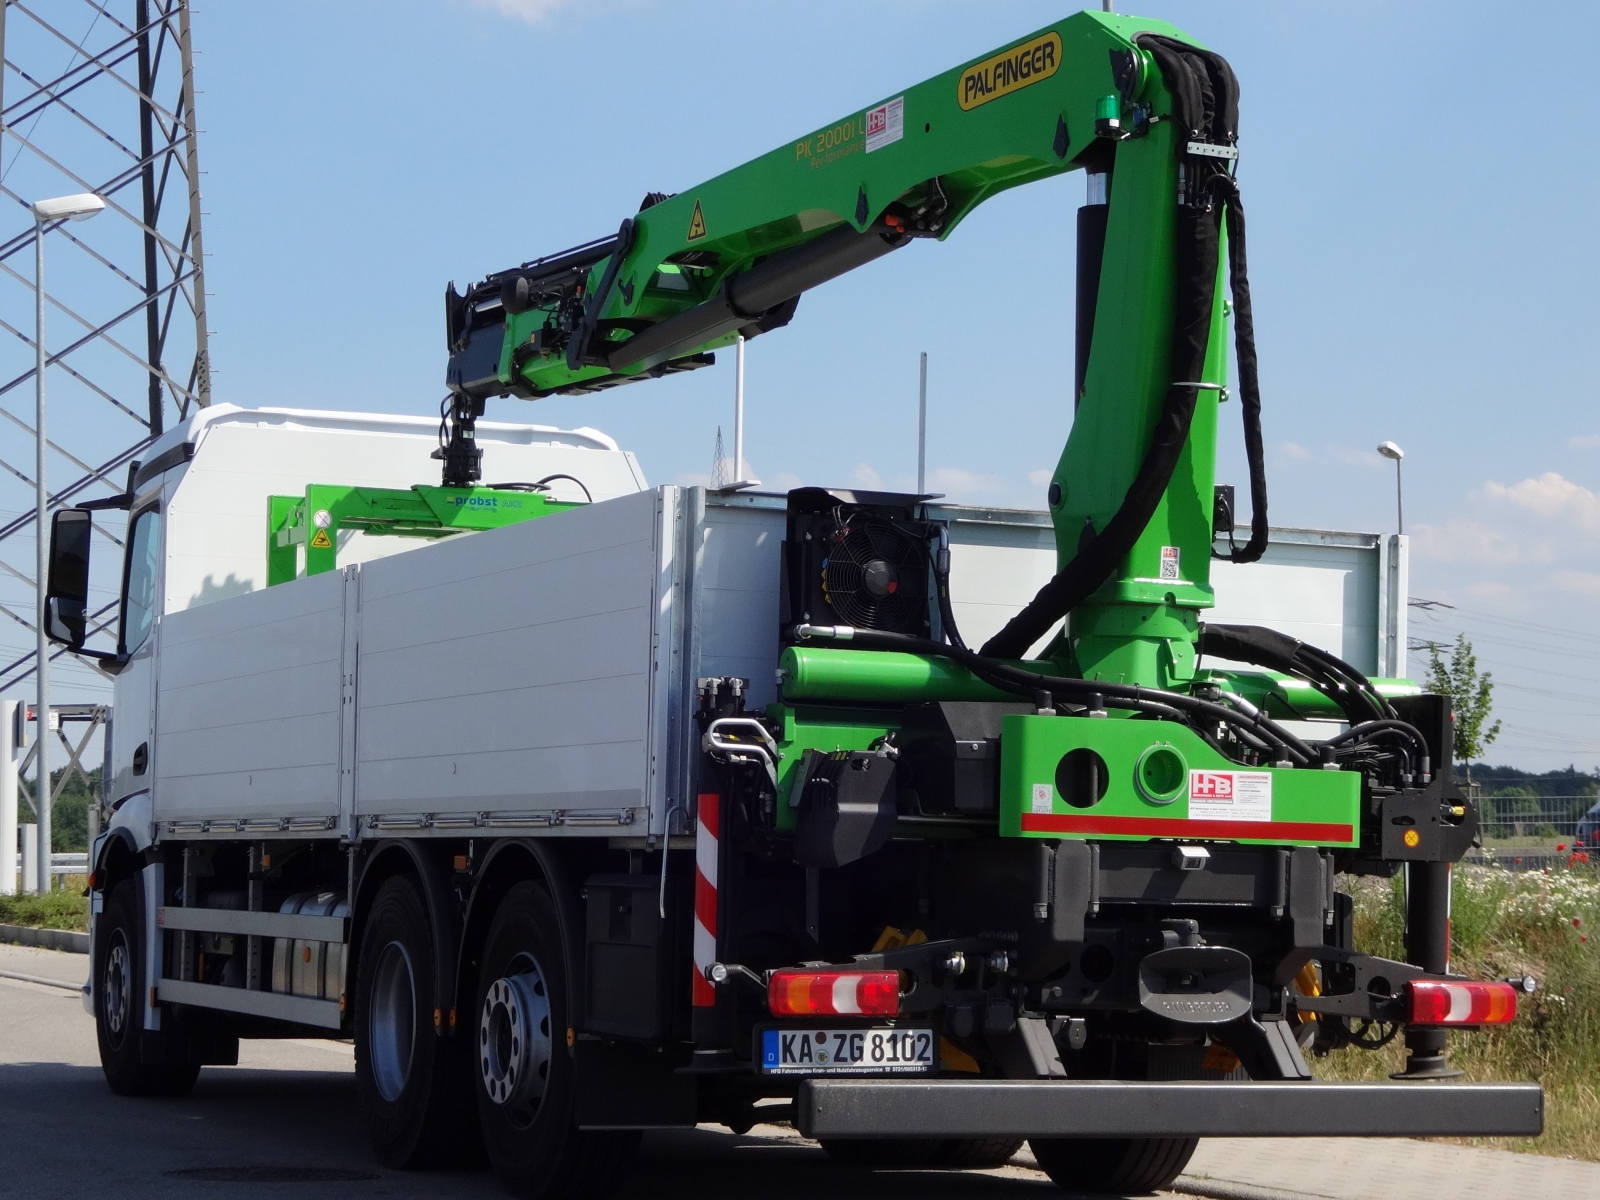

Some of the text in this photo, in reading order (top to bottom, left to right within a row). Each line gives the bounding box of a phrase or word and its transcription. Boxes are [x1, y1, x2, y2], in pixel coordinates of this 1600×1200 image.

[964, 40, 1055, 104] PALFINGER
[796, 138, 812, 162] PK
[858, 116, 865, 135] L
[455, 496, 498, 506] probst
[1192, 773, 1231, 795] HFB
[768, 1052, 775, 1062] D
[781, 1033, 931, 1064] KA ZG 8102
